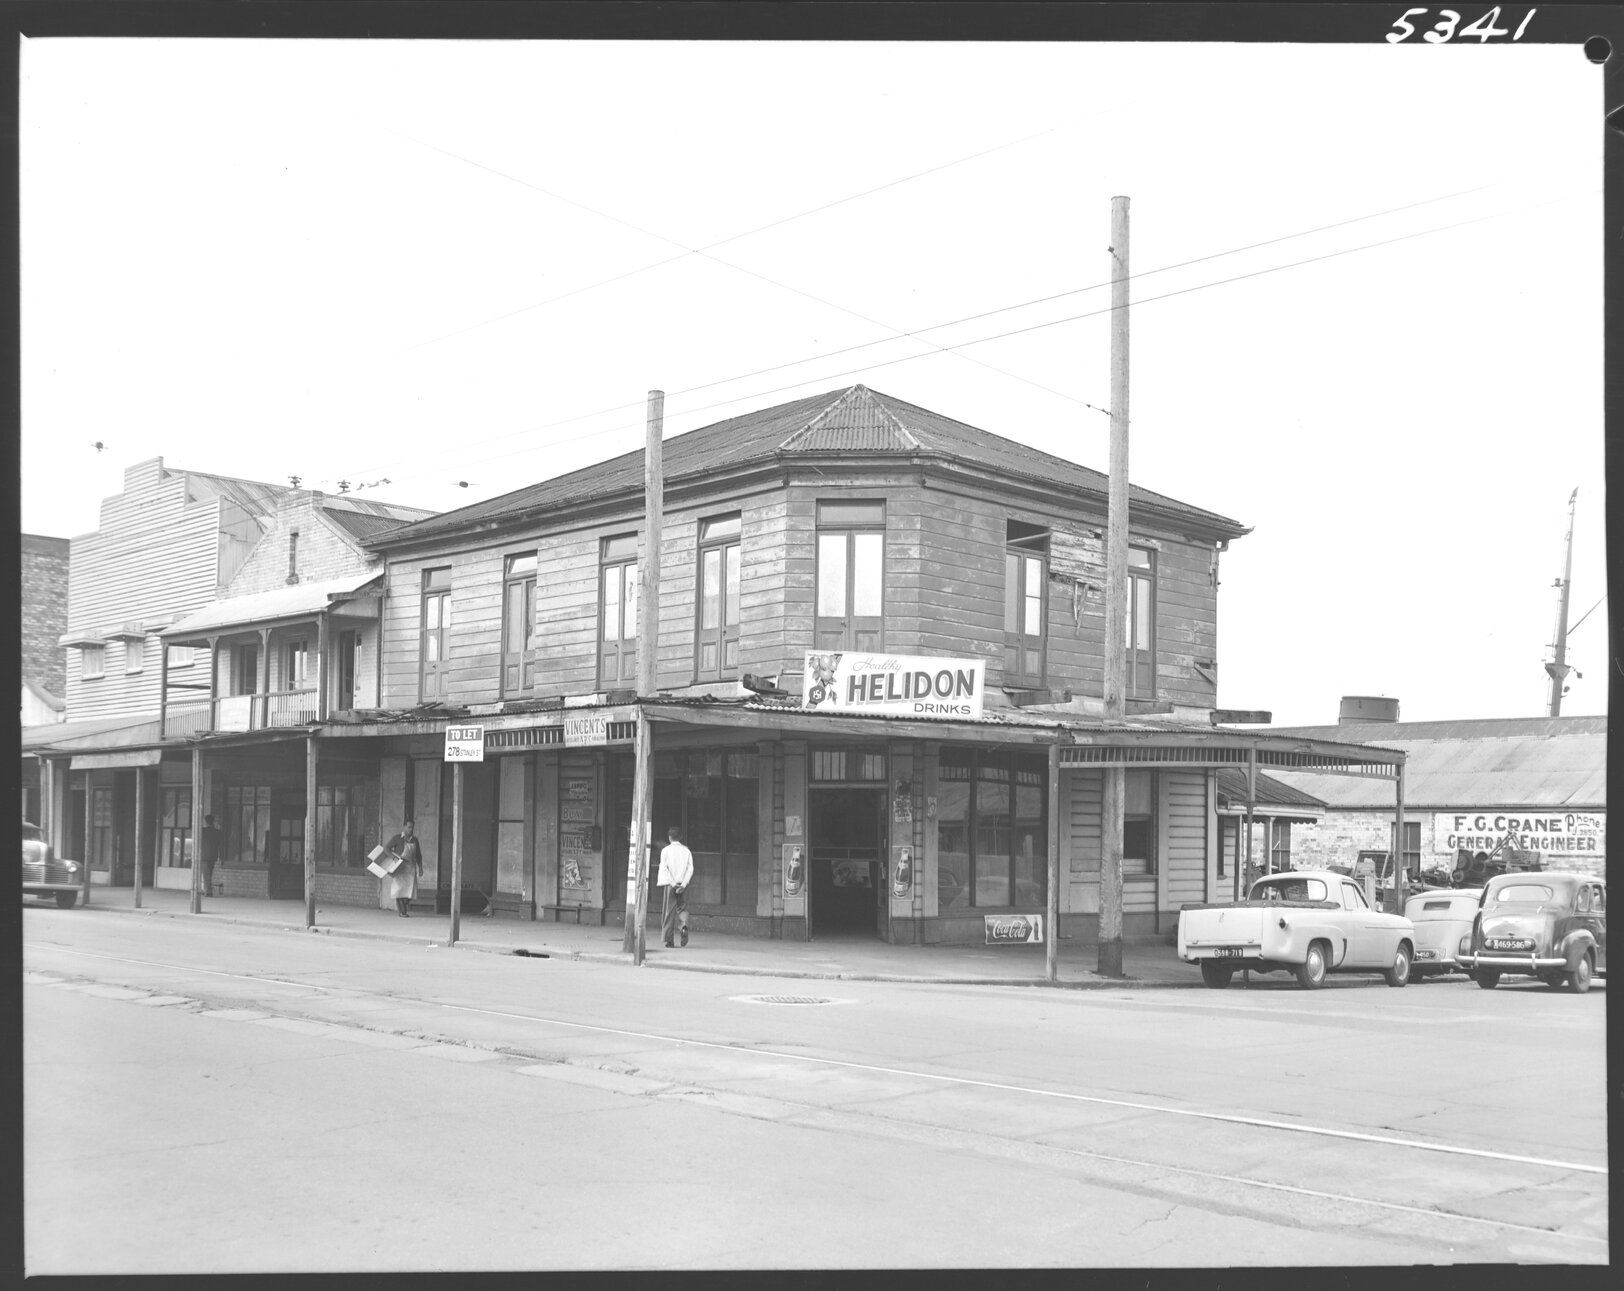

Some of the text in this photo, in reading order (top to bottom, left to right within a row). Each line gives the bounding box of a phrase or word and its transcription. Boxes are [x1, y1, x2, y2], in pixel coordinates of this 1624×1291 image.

[1385, 6, 1537, 43] 5341
[852, 657, 902, 673] Healthy
[846, 668, 975, 704] HELIDON
[914, 703, 971, 714] DRINKS
[450, 729, 478, 740] TO LET
[447, 746, 461, 757] 278
[562, 835, 584, 848] VINCEN
[1520, 835, 1596, 850] ENGINEER
